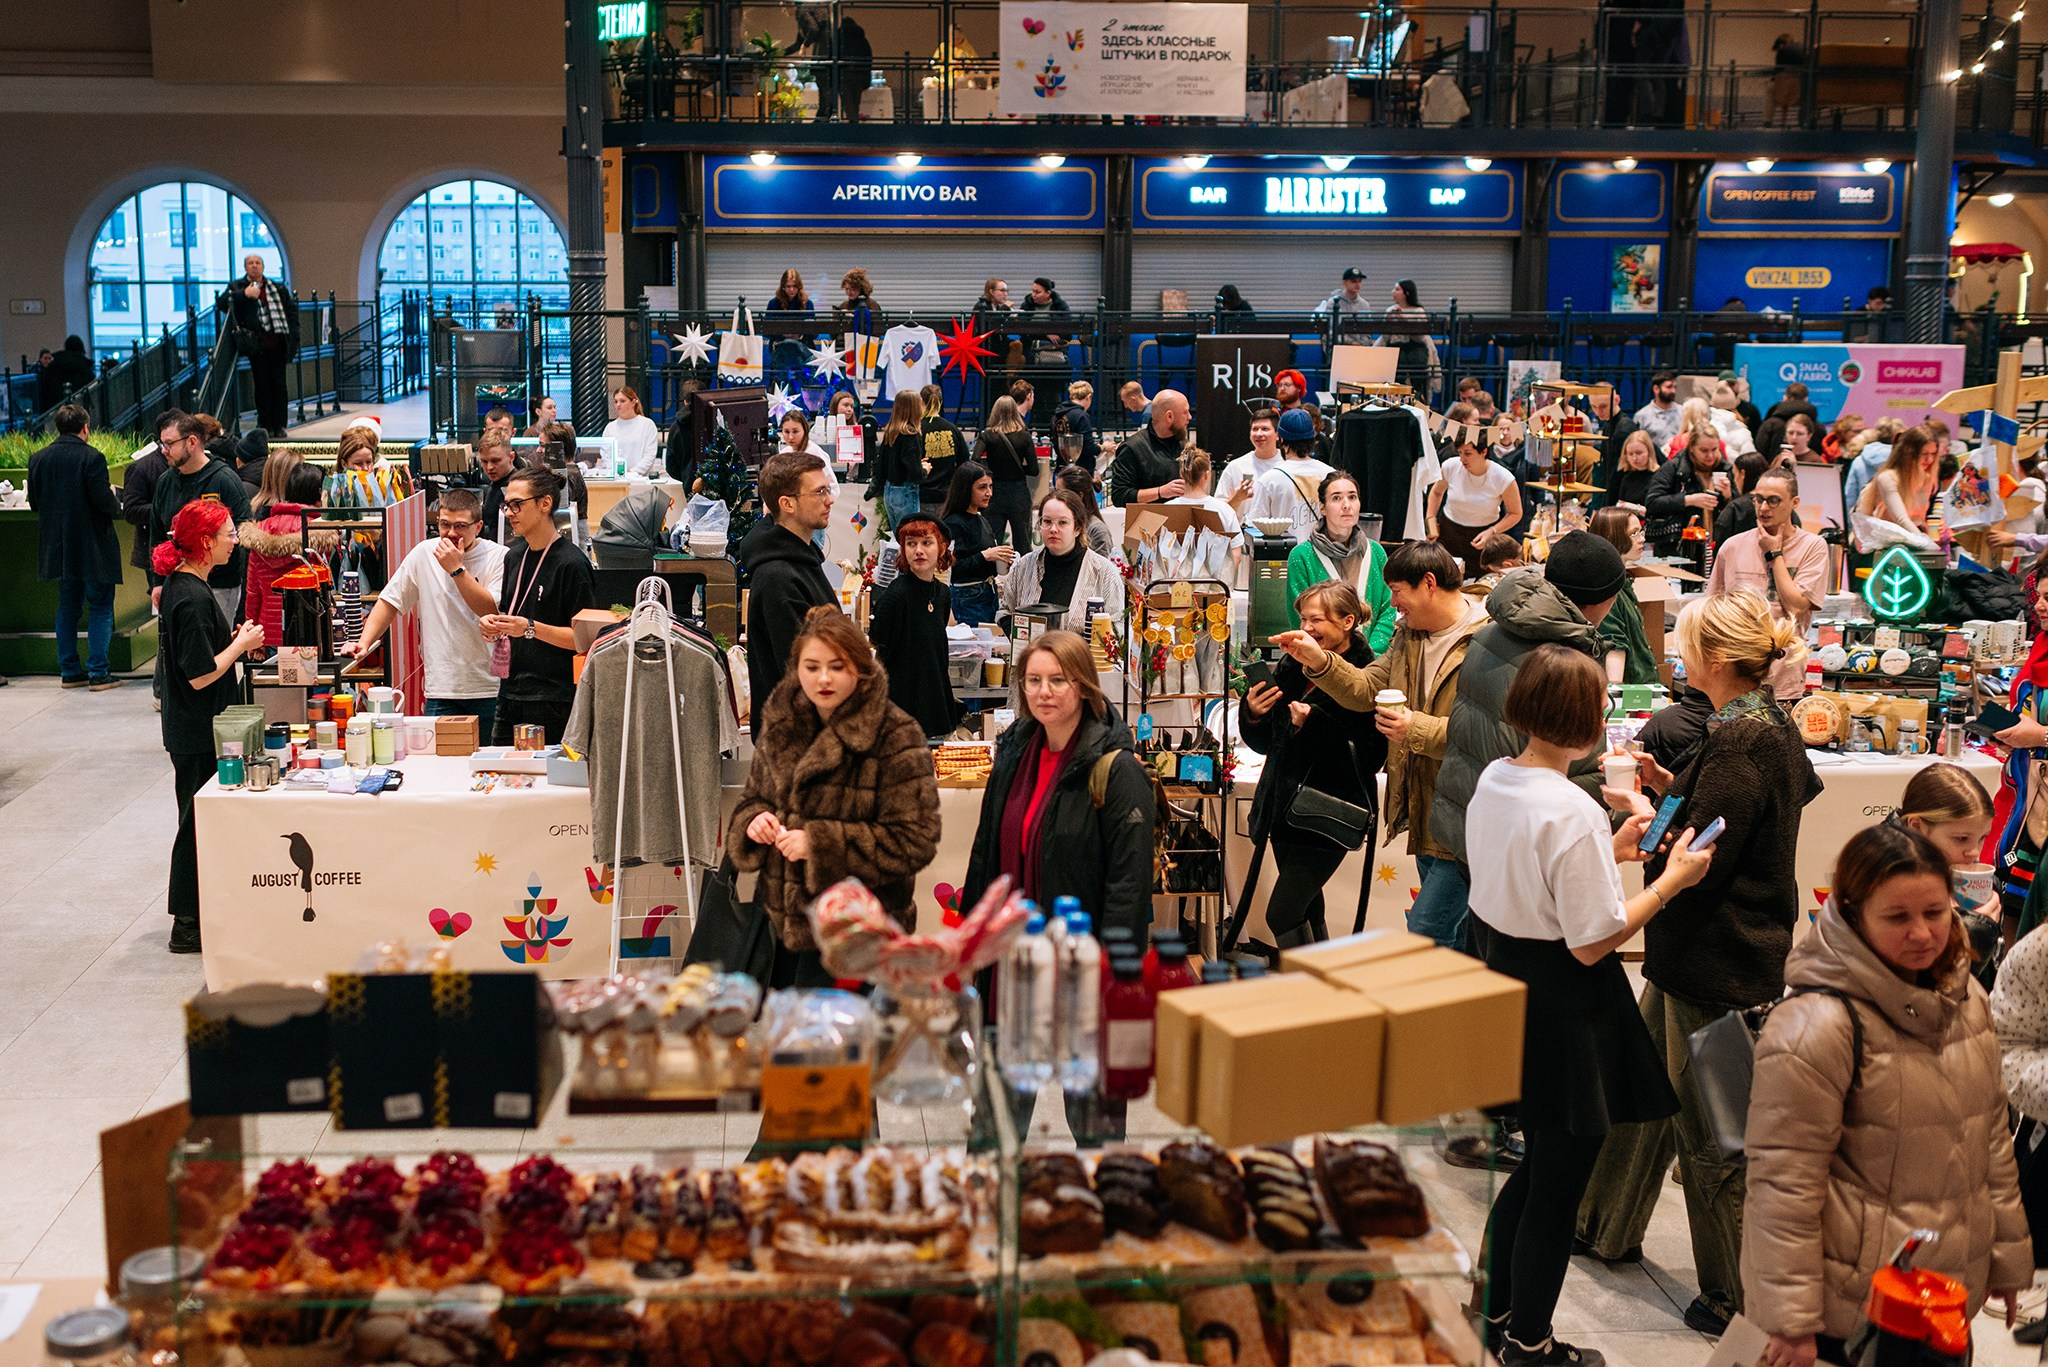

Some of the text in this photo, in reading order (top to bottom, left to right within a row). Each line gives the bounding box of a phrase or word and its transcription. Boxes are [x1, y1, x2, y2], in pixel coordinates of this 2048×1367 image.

[1102, 18, 1118, 31] 2
[1101, 35, 1217, 47] ЗДЕСЬ КЛАССНЫЕ
[1101, 50, 1232, 62] ШТУЧКИ В ПОДАРОК
[832, 184, 977, 201] APERITIVO BAR
[1190, 186, 1228, 204] BAR
[1265, 177, 1388, 214] BARRISTER
[1722, 190, 1817, 201] OPEN COFFEE FEST
[1752, 270, 1824, 285] VOKZAL 1853
[1799, 362, 1829, 373] SNAQ
[1882, 366, 1939, 378] CHIKALAB
[1798, 372, 1832, 382] FABRIQ
[740, 416, 749, 424] LG
[549, 824, 589, 836] OPEN
[251, 872, 362, 888] AUGUST COFFEE
